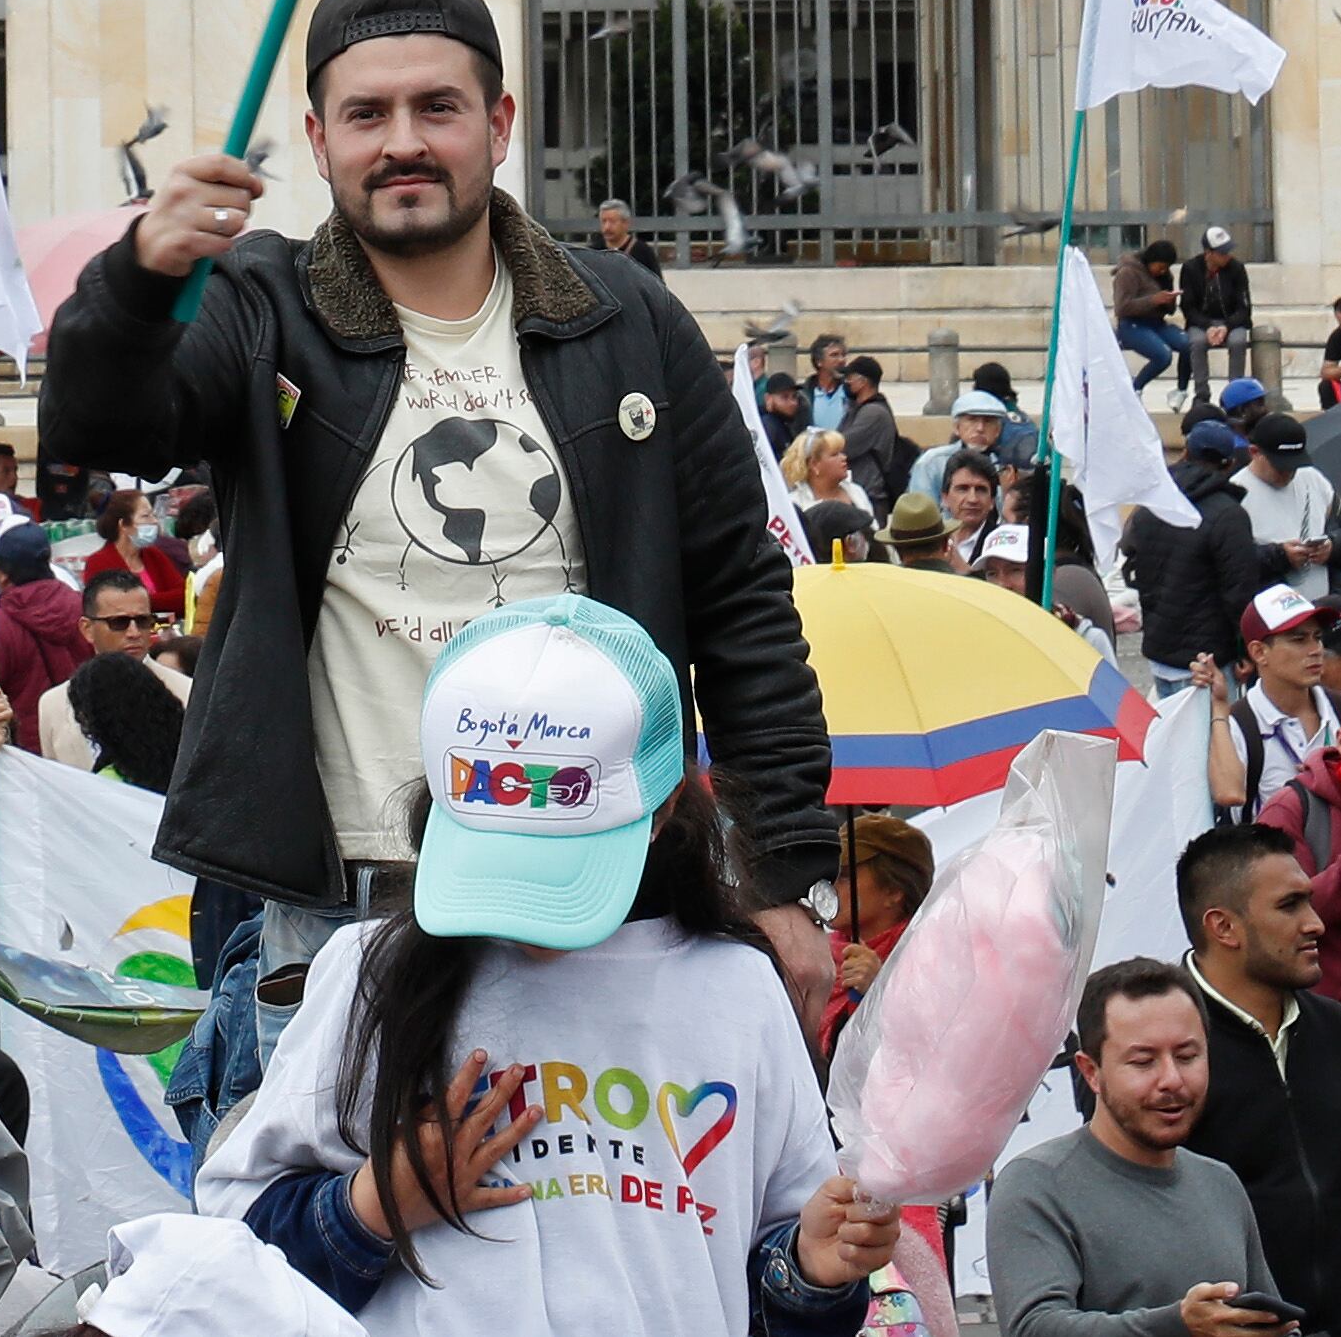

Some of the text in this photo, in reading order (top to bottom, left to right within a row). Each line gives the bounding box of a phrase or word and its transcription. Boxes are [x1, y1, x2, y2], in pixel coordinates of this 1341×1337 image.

[429, 620, 454, 644] all
[456, 707, 592, 747] Bogotá Marca
[450, 756, 593, 809] PACTO
[621, 1173, 664, 1211] DE
